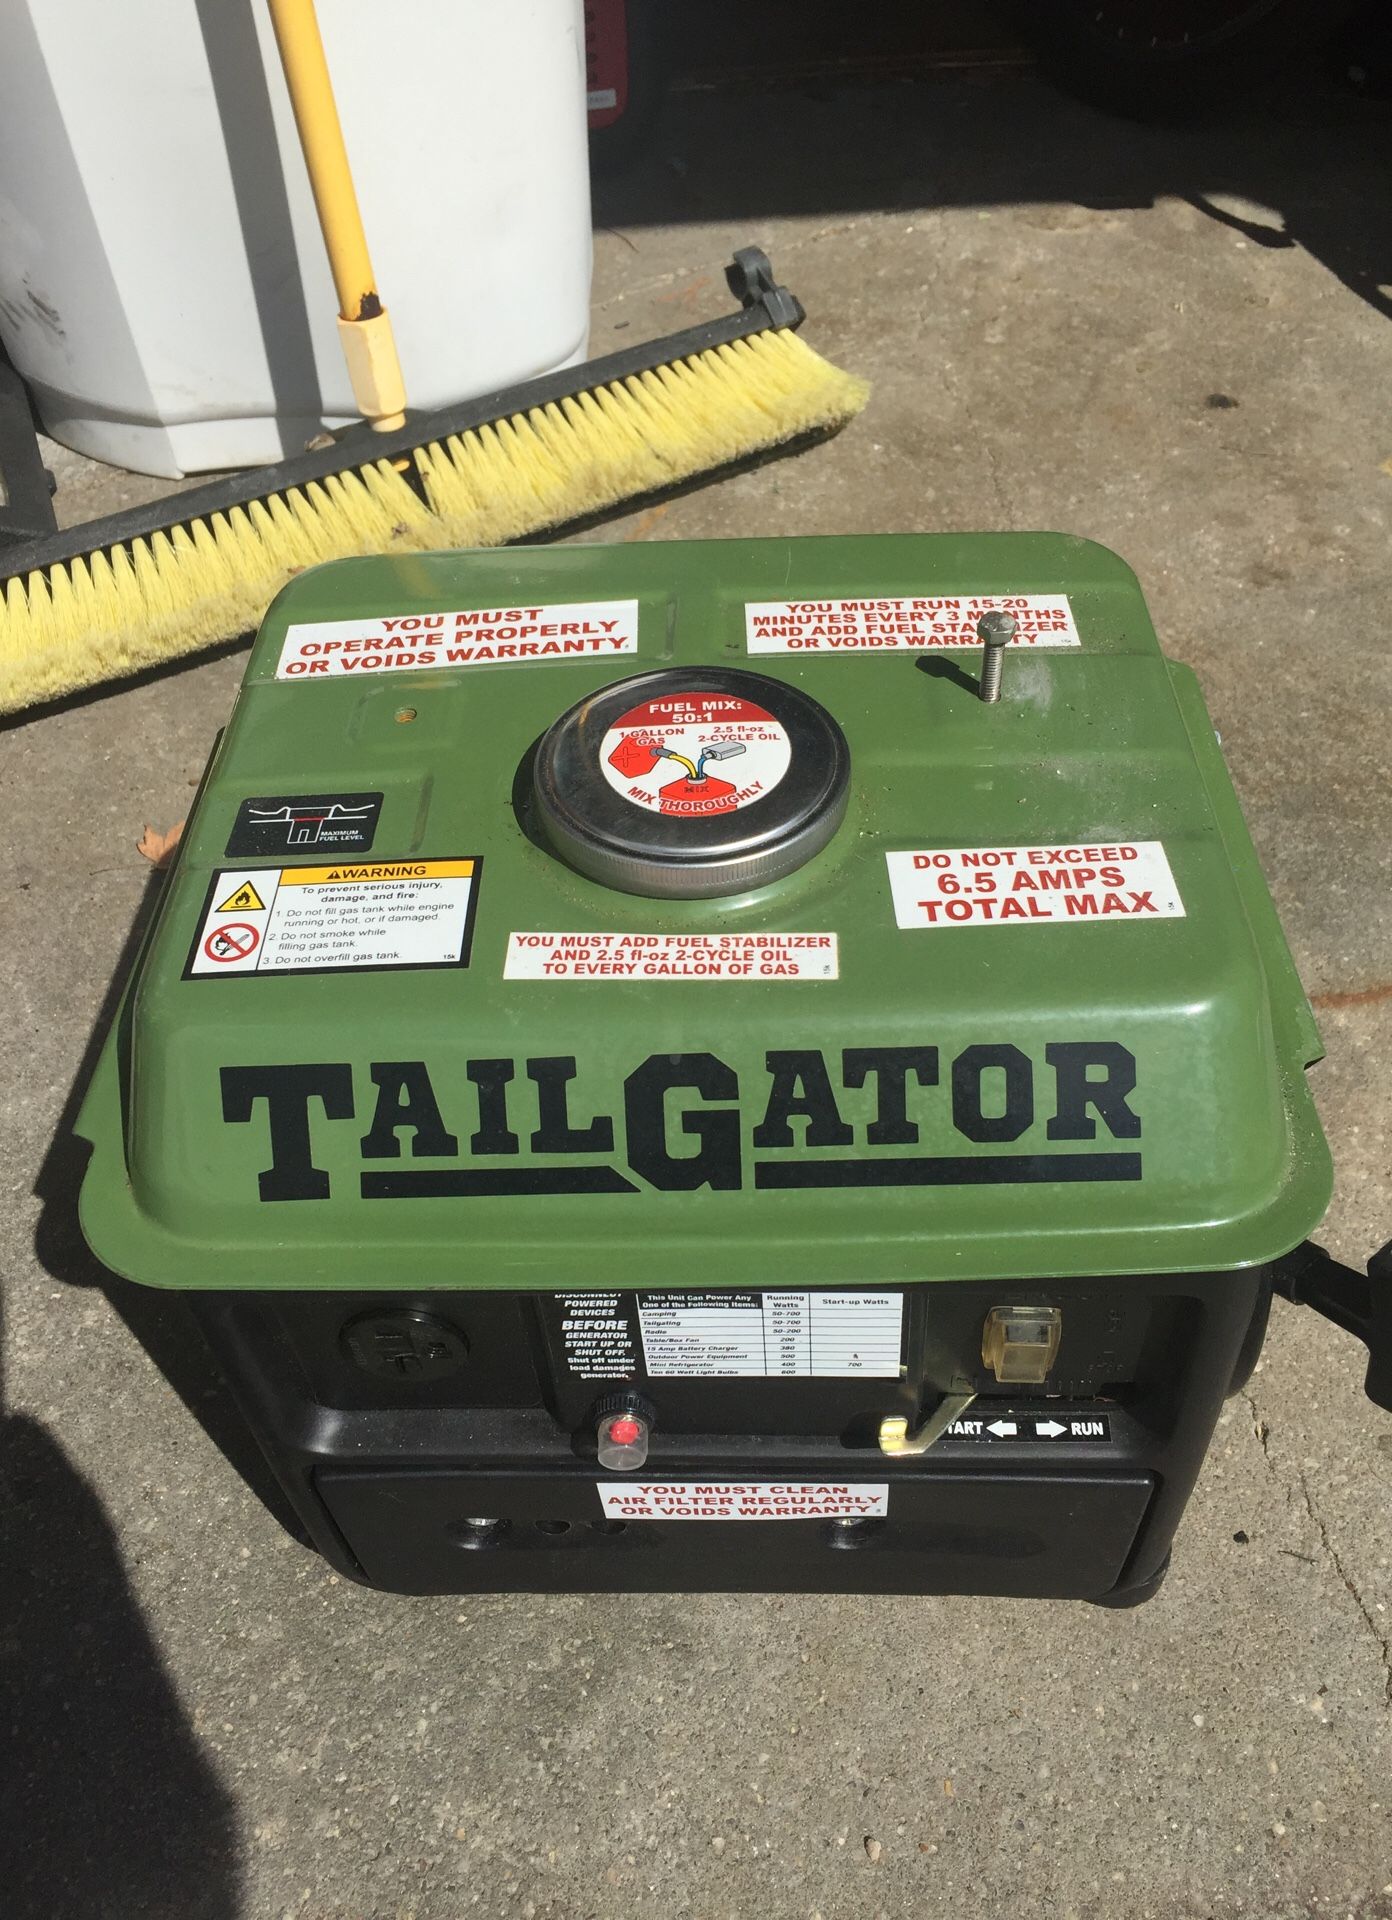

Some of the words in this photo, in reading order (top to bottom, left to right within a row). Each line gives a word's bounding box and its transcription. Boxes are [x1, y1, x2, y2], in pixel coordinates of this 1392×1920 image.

[786, 602, 833, 614] YOU
[841, 600, 905, 612] MUST
[911, 599, 961, 610] RUN
[969, 598, 1028, 609] 15-20
[381, 615, 445, 632] YOU
[455, 609, 544, 626] MUST
[752, 613, 859, 627] MINUTES
[864, 610, 939, 624] EVERY
[946, 610, 960, 621] 3
[966, 609, 1066, 620] MNTHS
[755, 625, 803, 637] AND
[811, 623, 858, 635] ADD
[866, 622, 925, 634] FUEL
[299, 633, 444, 656] OPERATE
[454, 620, 620, 644] PROPERLY
[787, 638, 818, 649] OR
[826, 636, 899, 648] VOIDS
[285, 658, 330, 675] OR
[339, 651, 436, 671] VOIDS
[446, 636, 629, 662] WARRANTY
[649, 702, 697, 714] FUEL
[702, 700, 742, 711] MIX:
[671, 713, 713, 723] 50:1
[630, 727, 685, 738] GALLON
[737, 726, 765, 734] fl-oz
[637, 737, 665, 746] GAS
[698, 734, 754, 743] 2-CYCLE
[759, 733, 781, 741] OIL
[627, 786, 657, 805] MIX
[660, 781, 765, 812] THOROUGHLY
[913, 853, 952, 870] DO
[961, 851, 1017, 867] NOT
[1027, 846, 1138, 865] EXCEED
[342, 865, 426, 880] WARNING
[937, 871, 997, 894] 6.5
[1011, 866, 1126, 892] AMPS
[301, 886, 314, 894] To
[317, 884, 360, 895] prevent
[363, 882, 405, 891] serious
[372, 892, 394, 900] and
[286, 909, 302, 917] Do
[305, 908, 322, 916] not
[325, 907, 337, 915] fill
[339, 908, 359, 916] gas
[362, 905, 385, 913] tank
[388, 904, 415, 912] while
[418, 903, 454, 912] engine
[917, 897, 1053, 922] TOTAL
[1064, 891, 1159, 916] MAX
[284, 919, 324, 927] running
[281, 932, 296, 940] Do
[299, 931, 317, 939] not
[320, 930, 355, 938] smoke
[359, 928, 386, 936] while
[278, 942, 306, 951] filling
[309, 942, 329, 950] gas
[516, 936, 555, 947] YOU
[560, 936, 615, 947] MUST
[621, 936, 659, 947] ADD
[665, 937, 713, 948] FUEL
[719, 936, 832, 948] STABILIZER
[275, 956, 291, 964] Do
[294, 955, 311, 963] not
[314, 953, 350, 962] overfill
[353, 953, 373, 962] gas
[551, 949, 591, 961] AND
[597, 949, 624, 961] 2.5
[630, 949, 670, 961] fl-oz
[675, 949, 755, 961] 2-CYCLE
[760, 949, 793, 961] OIL
[542, 963, 568, 975] TO
[573, 963, 639, 975] EVERY
[643, 963, 722, 975] GALLON
[728, 963, 754, 975] OF
[759, 963, 800, 975] GAS
[219, 1041, 1142, 1202] TAILGATOR
[564, 1299, 619, 1308] POWERED
[734, 1294, 752, 1302] Any
[766, 1294, 805, 1302] Running
[687, 1301, 730, 1309] Following
[570, 1308, 616, 1316] DEVICES
[561, 1319, 628, 1331] BEFORE
[565, 1340, 598, 1348] START
[600, 1340, 615, 1348] UP
[617, 1340, 632, 1348] OR
[574, 1348, 601, 1356] SHUT
[567, 1356, 590, 1364] Shut
[591, 1356, 605, 1364] off
[607, 1356, 635, 1364] under
[592, 1364, 636, 1372] damages
[1071, 1422, 1104, 1436] RUN
[637, 1486, 687, 1494] YOU
[694, 1486, 762, 1494] MUST
[769, 1486, 848, 1494] CLEAN
[608, 1496, 648, 1505] AIR
[654, 1496, 736, 1505] FILTER
[741, 1496, 882, 1505] REGULARLY
[620, 1507, 654, 1516] OR
[660, 1507, 731, 1516] VOIDS
[737, 1505, 871, 1516] WARRANTY
